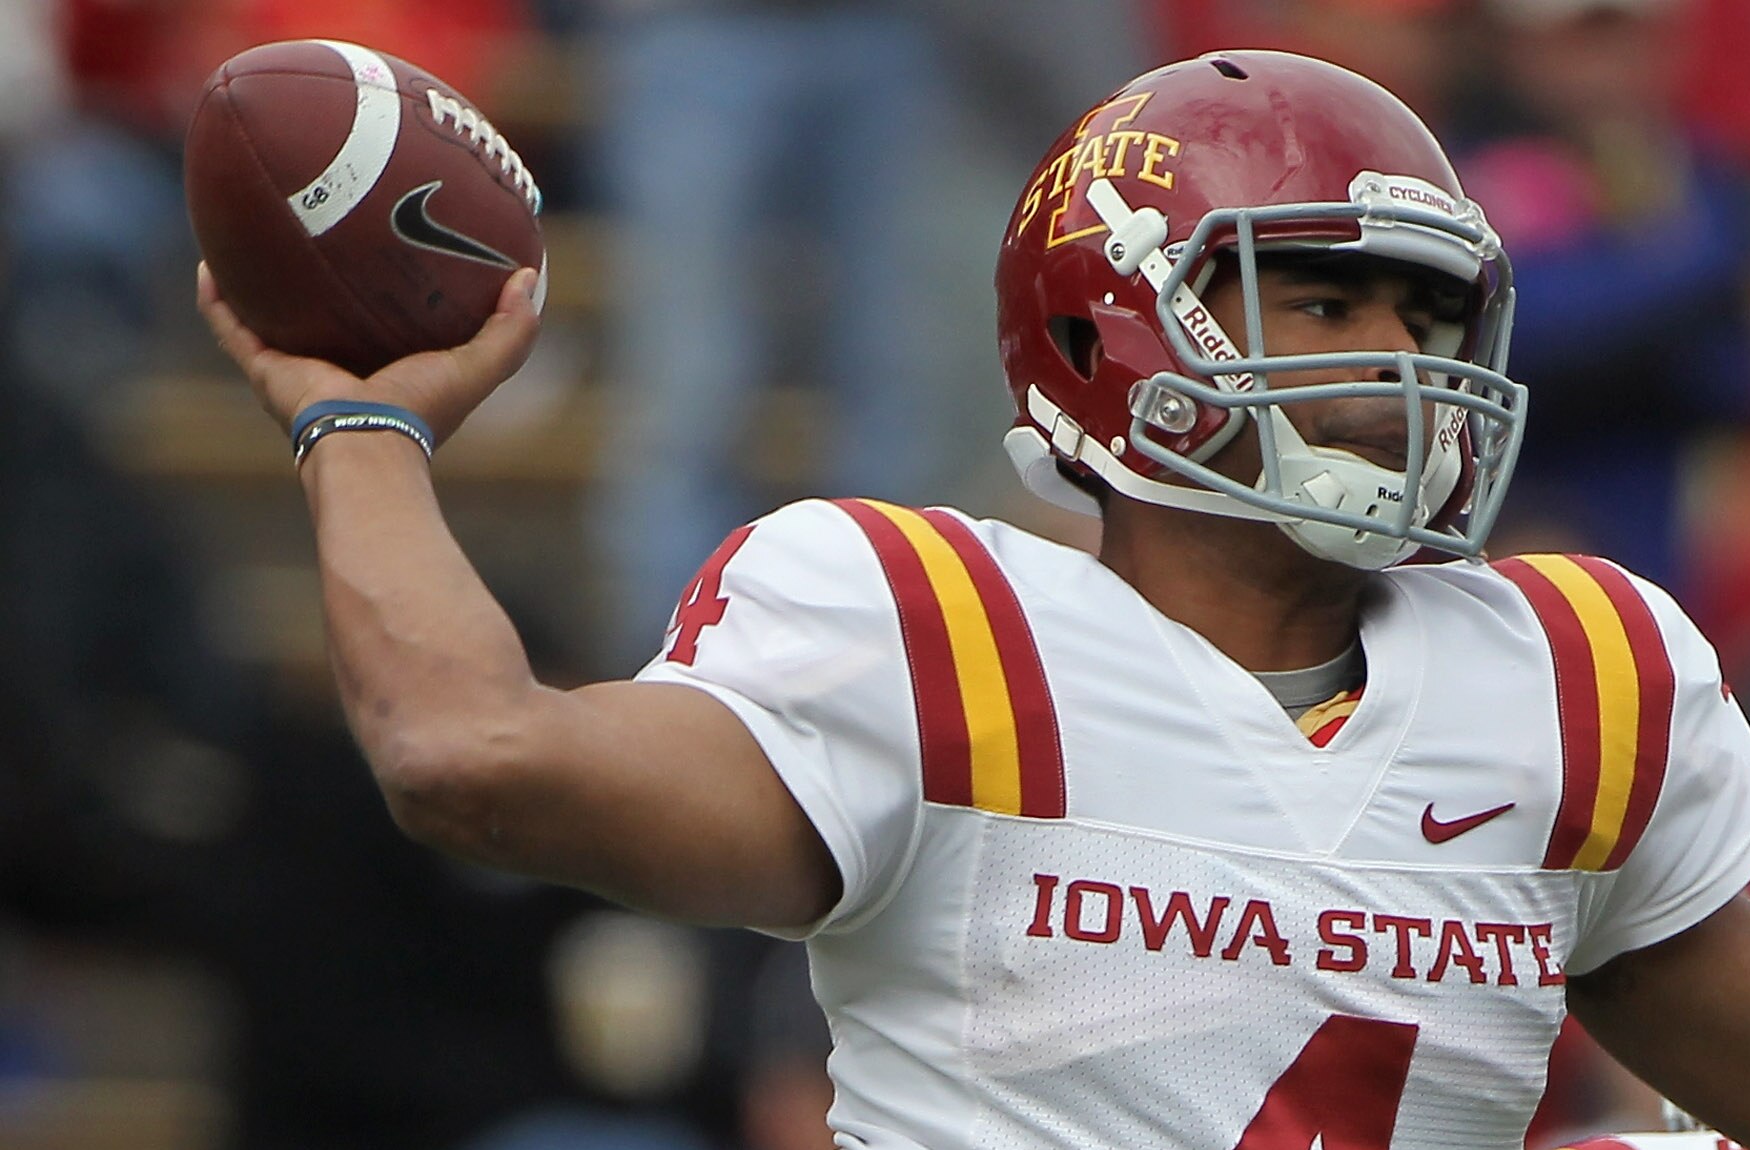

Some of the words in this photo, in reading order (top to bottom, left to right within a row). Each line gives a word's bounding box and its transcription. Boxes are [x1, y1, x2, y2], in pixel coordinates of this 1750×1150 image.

[1016, 130, 1180, 238] STATE
[666, 524, 757, 667] 4
[1026, 873, 1291, 966] IOWA
[1316, 909, 1567, 987] STATE
